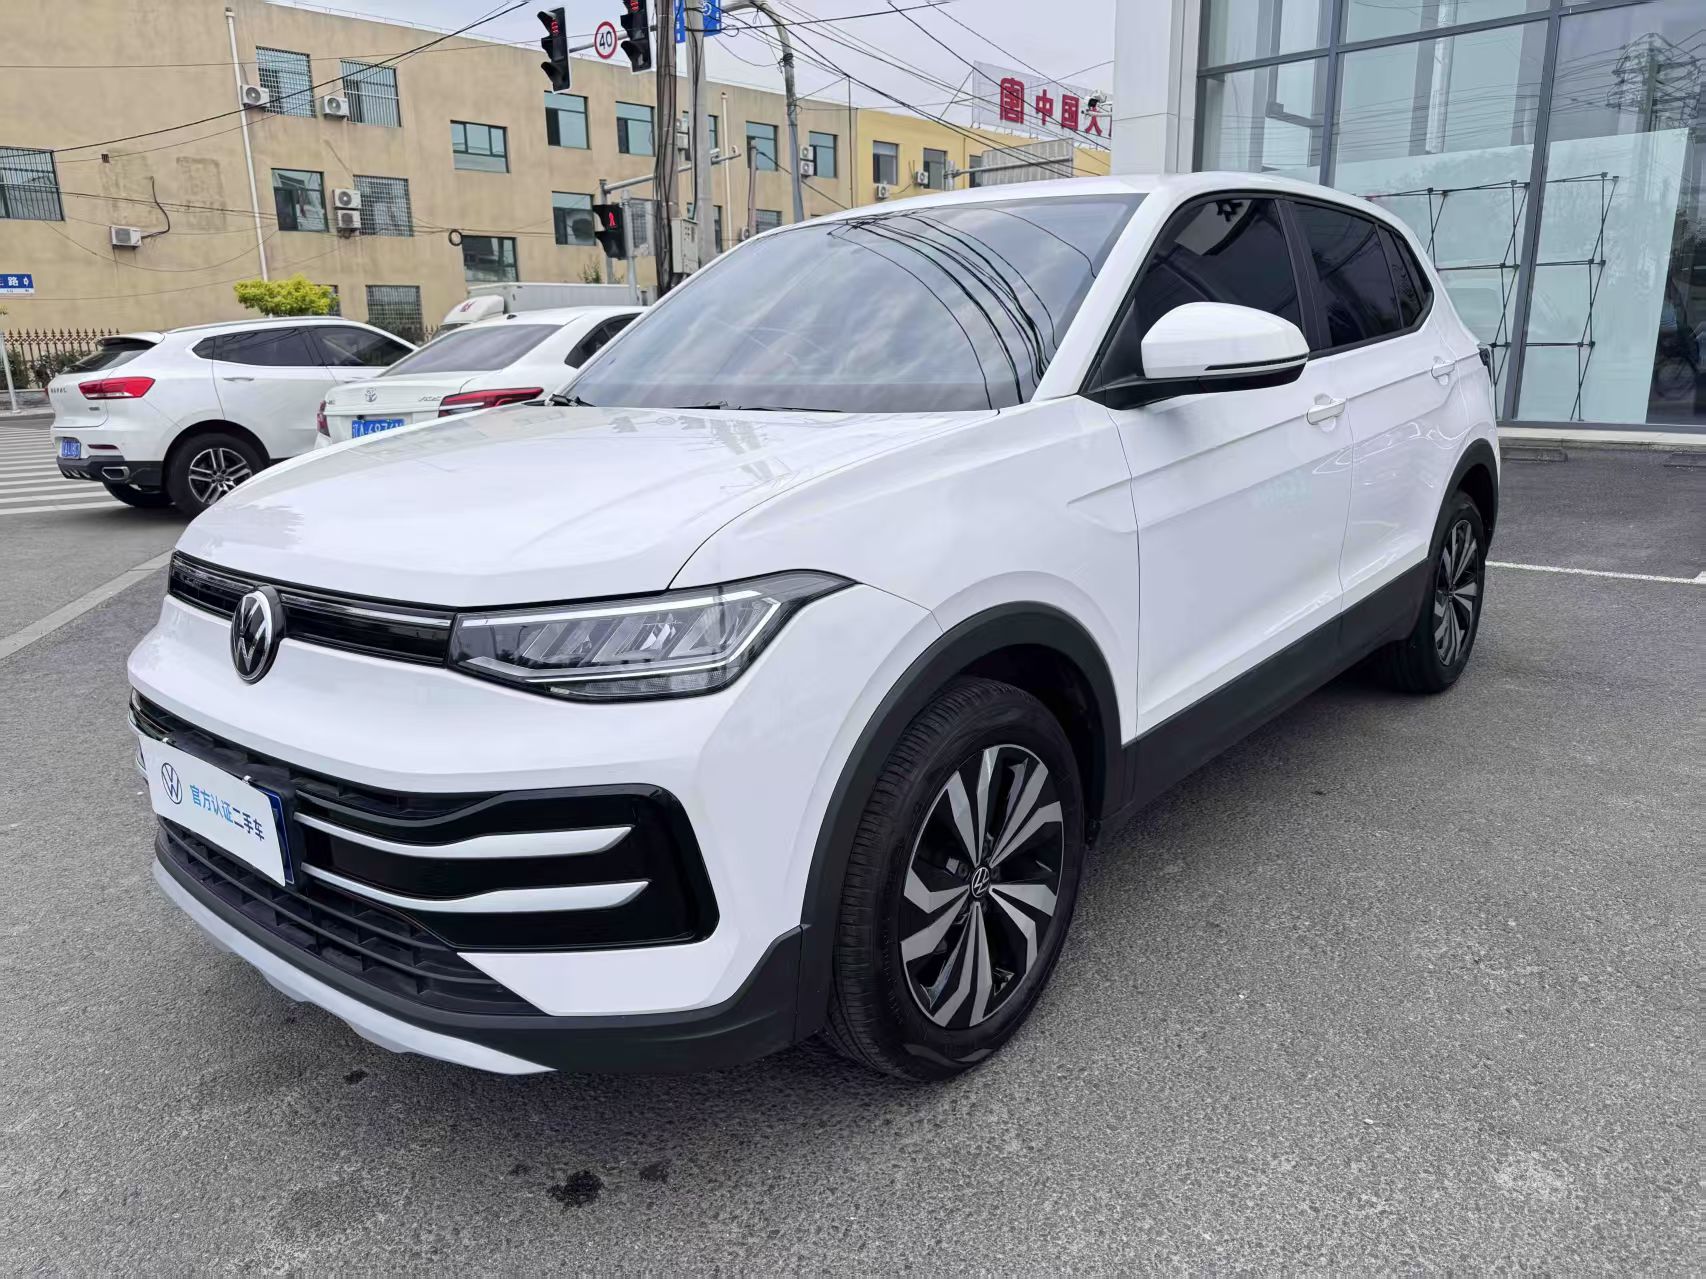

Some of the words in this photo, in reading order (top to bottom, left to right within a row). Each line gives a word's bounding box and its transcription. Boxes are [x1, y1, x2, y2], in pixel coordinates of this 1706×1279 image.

[599, 31, 613, 50] 40
[189, 784, 265, 842] 官方认证二手车
